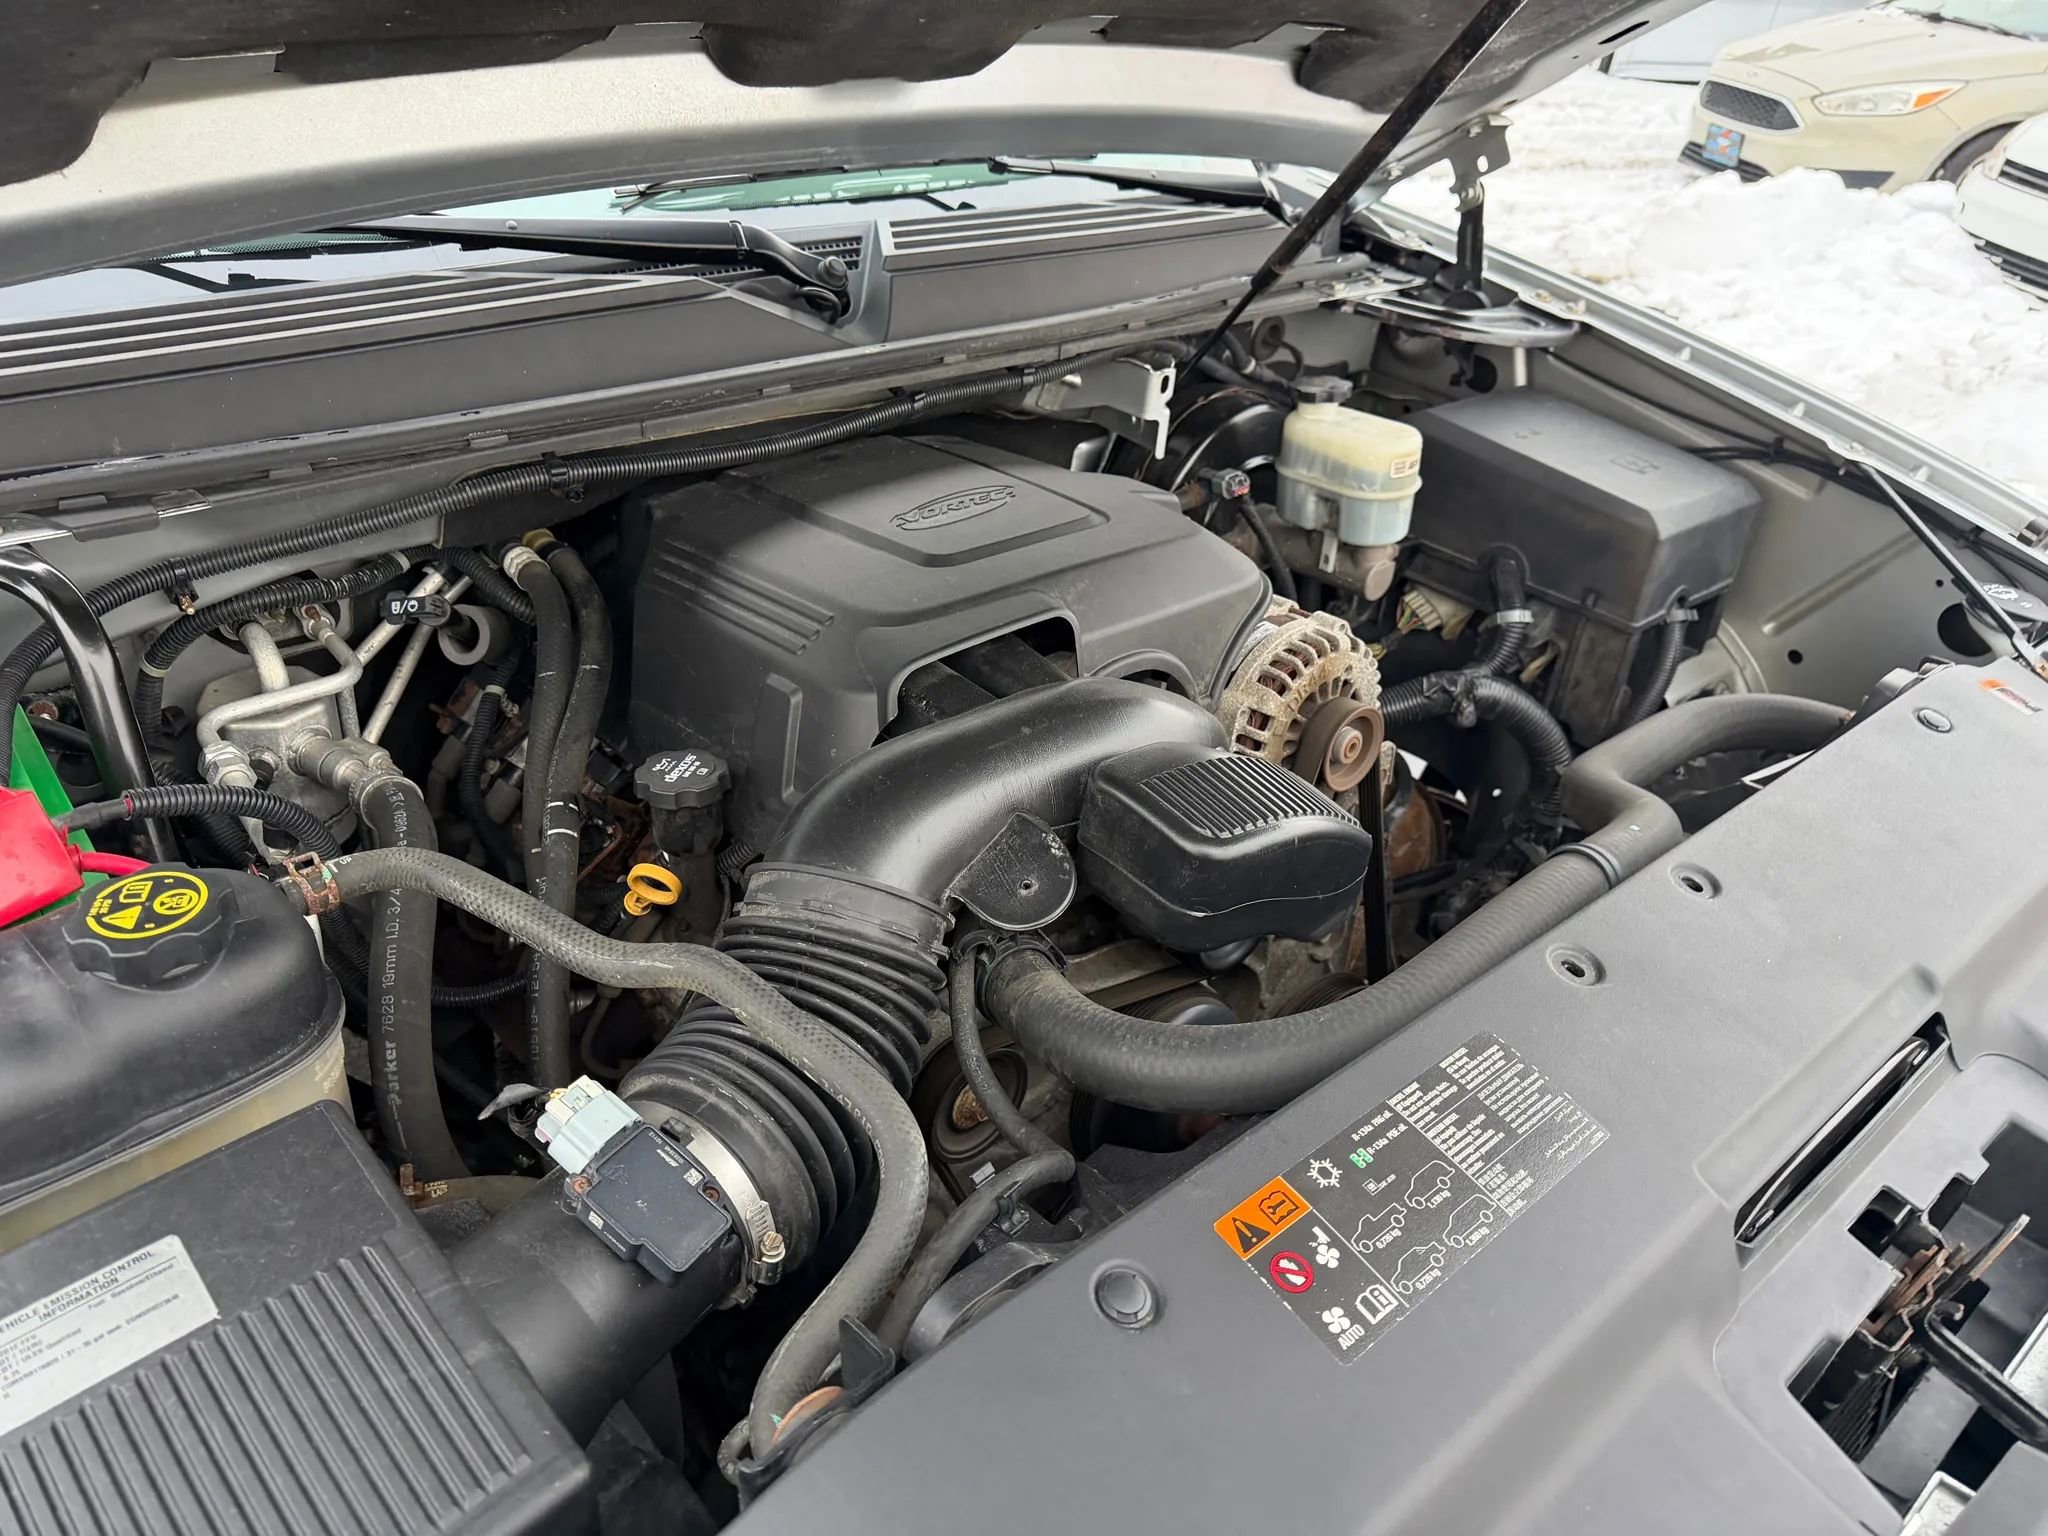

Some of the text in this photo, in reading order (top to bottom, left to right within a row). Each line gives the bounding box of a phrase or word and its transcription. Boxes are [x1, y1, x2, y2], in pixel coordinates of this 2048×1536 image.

[896, 491, 1016, 527] VORTEC
[664, 753, 697, 782] dexos
[386, 918, 400, 940] I.D.
[383, 944, 398, 989] 19mm
[380, 995, 395, 1034] 7628
[384, 1040, 402, 1105] Parker
[1351, 1124, 1374, 1141] R-134a
[1366, 1138, 1389, 1155] R-134a
[44, 1277, 100, 1311] EMISSION
[102, 1250, 156, 1280] CONTROL
[39, 1277, 119, 1322] INFORMATION
[1337, 1324, 1365, 1350] AUTO
